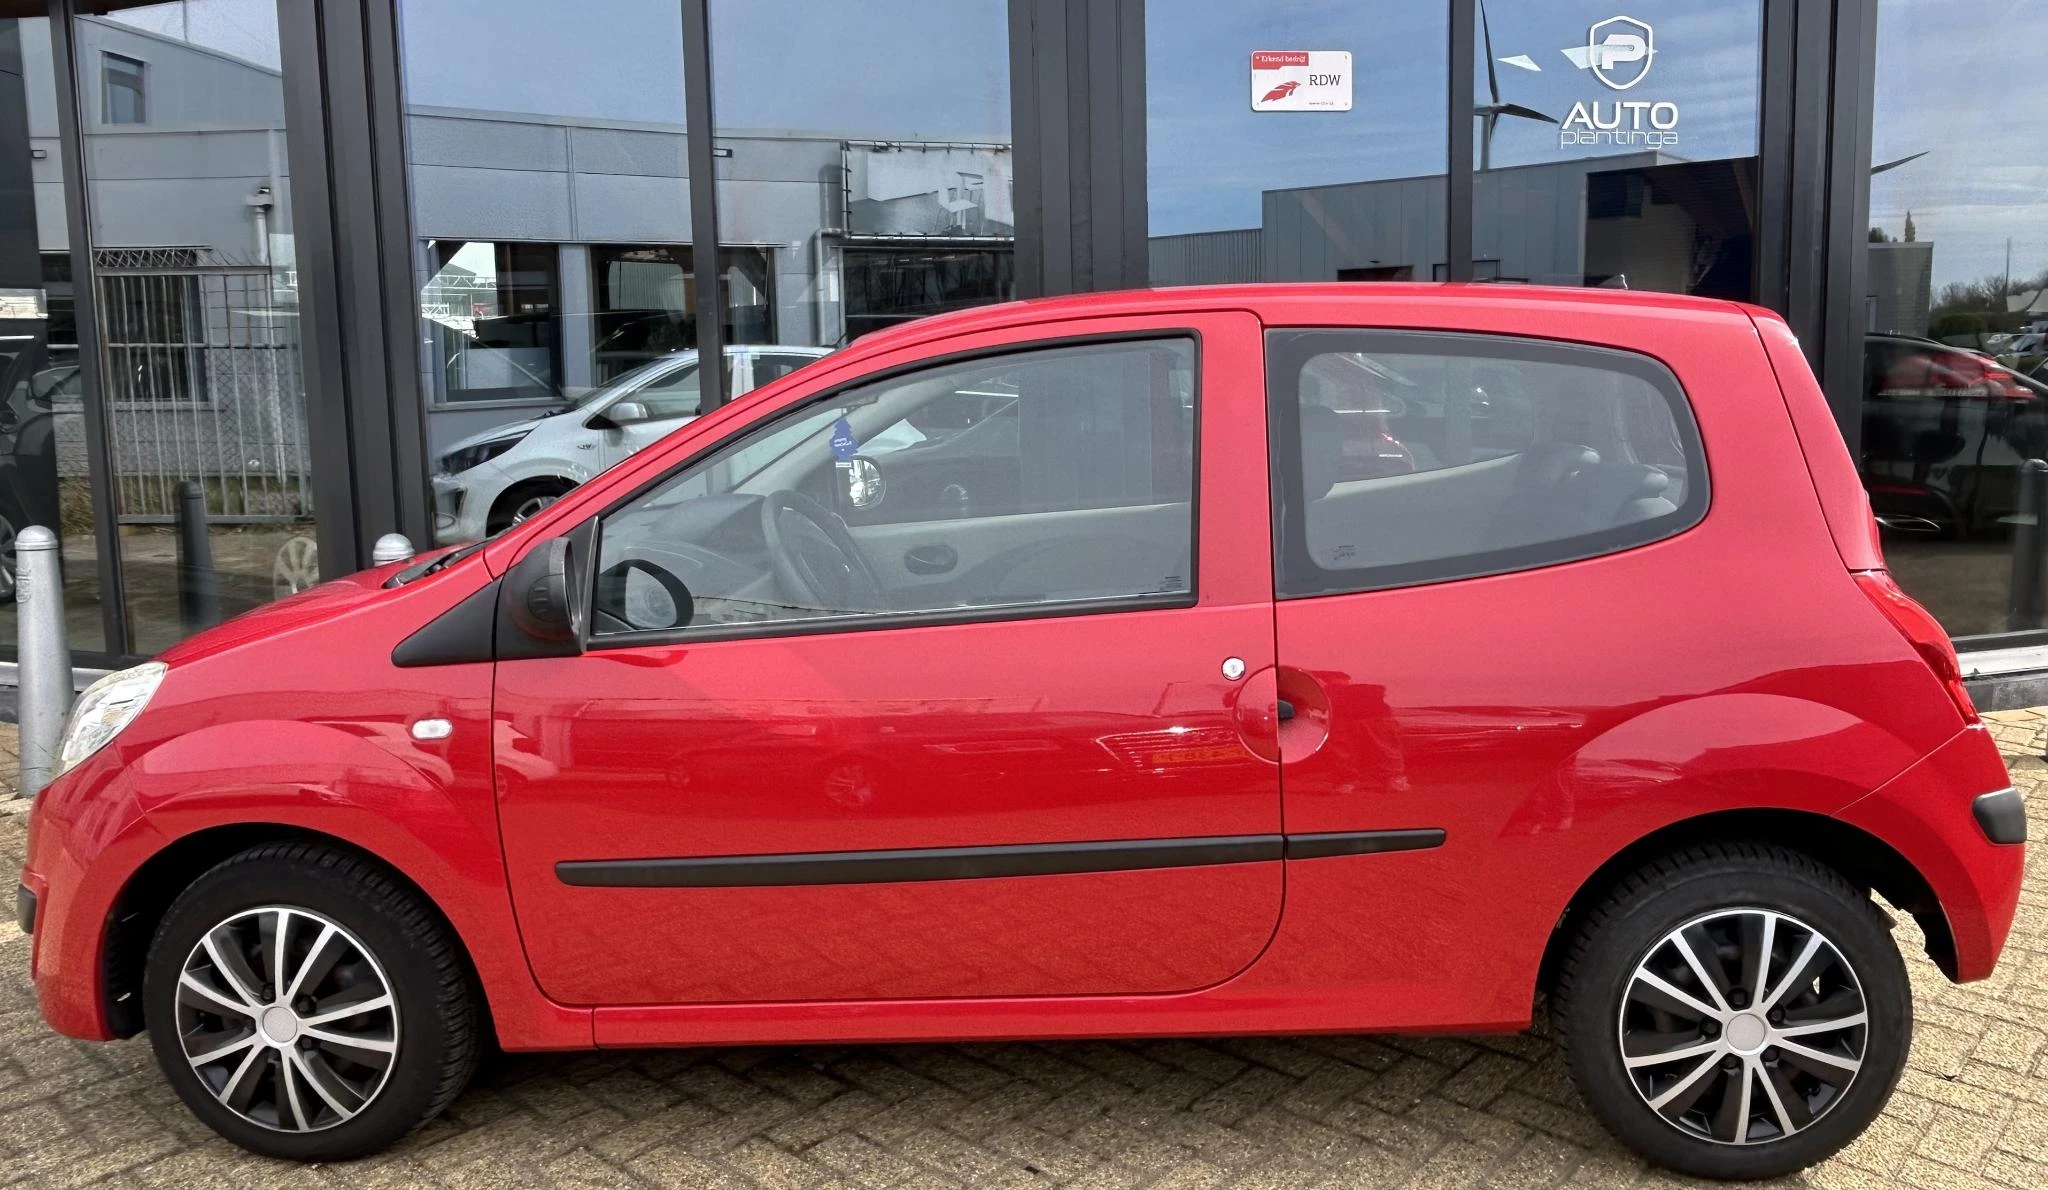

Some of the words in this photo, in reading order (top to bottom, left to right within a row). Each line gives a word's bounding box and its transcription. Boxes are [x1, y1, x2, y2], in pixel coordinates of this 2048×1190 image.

[1602, 34, 1647, 69] P
[1309, 74, 1342, 86] RDW
[1561, 101, 1679, 130] AUTO
[1560, 128, 1678, 150] plantinga
